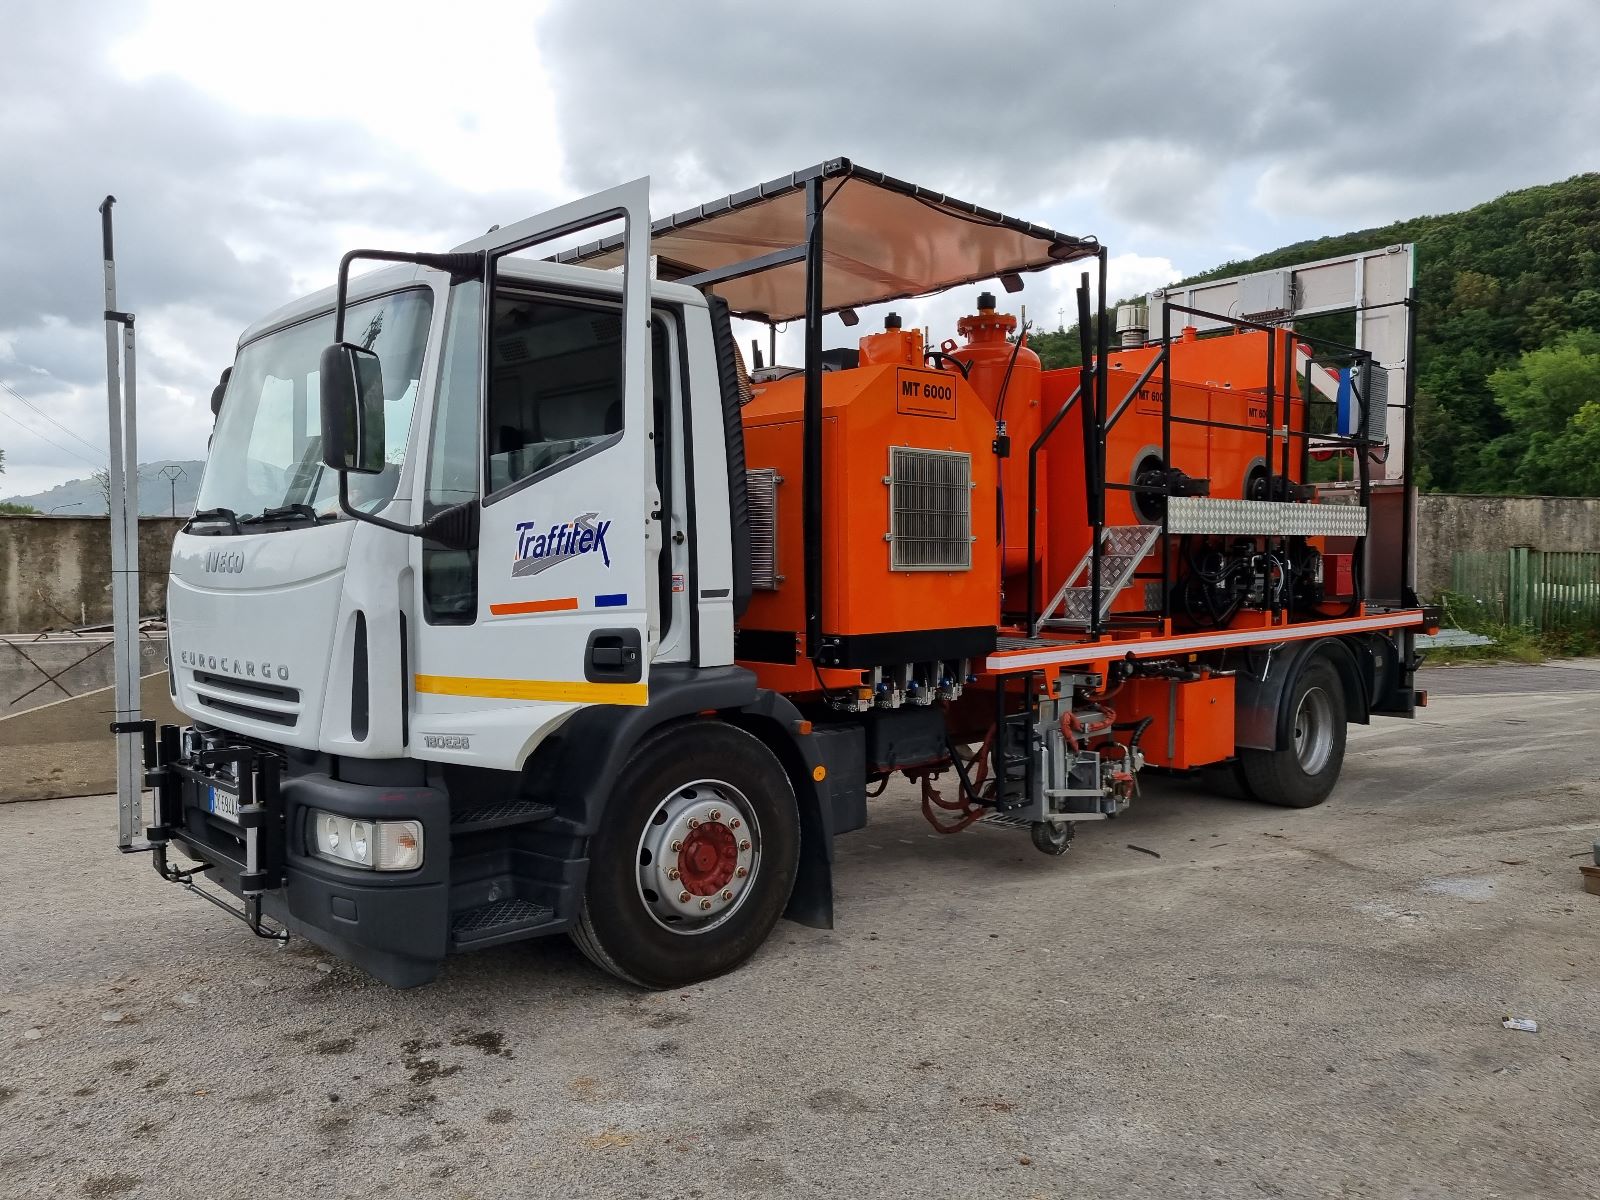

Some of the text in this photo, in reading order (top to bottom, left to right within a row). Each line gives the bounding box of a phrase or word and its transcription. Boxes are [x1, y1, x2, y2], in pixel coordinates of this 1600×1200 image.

[902, 381, 952, 400] MT 6000
[1138, 390, 1164, 402] MT 600
[1248, 407, 1258, 418] MT
[205, 551, 245, 574] IVECO
[181, 650, 289, 681] EUROCARGO
